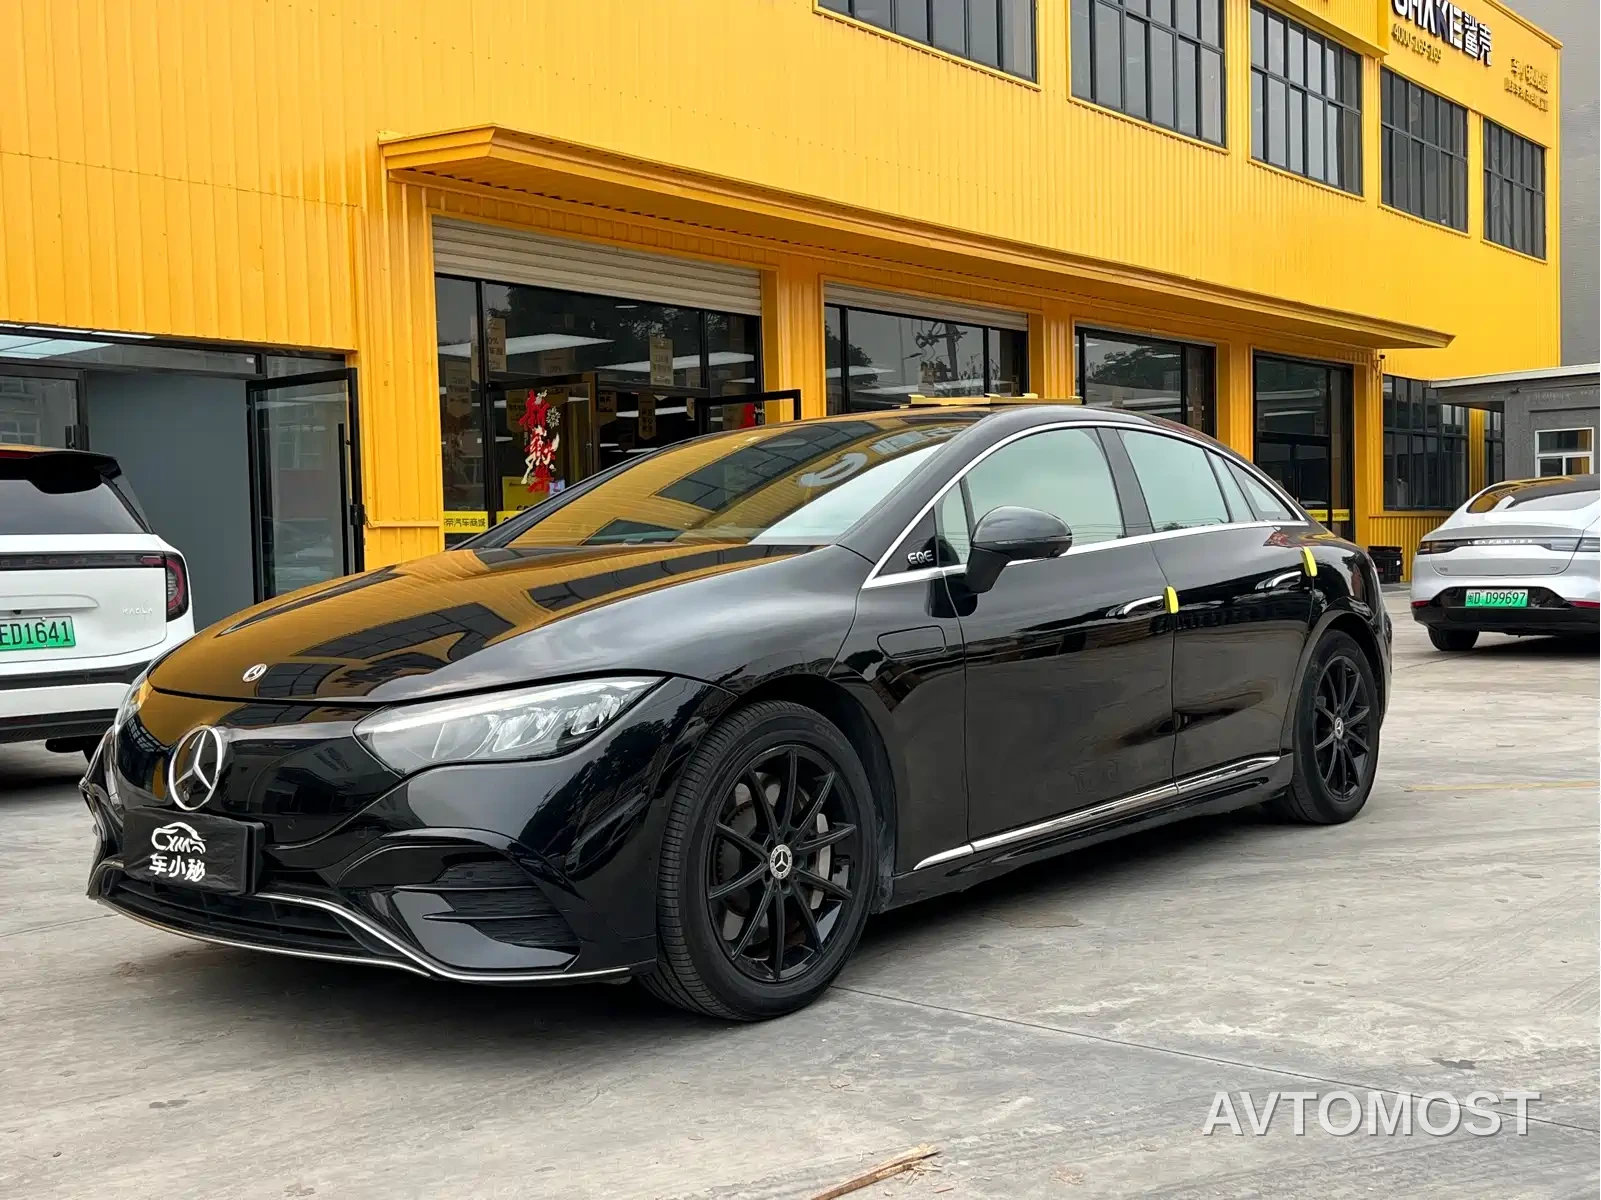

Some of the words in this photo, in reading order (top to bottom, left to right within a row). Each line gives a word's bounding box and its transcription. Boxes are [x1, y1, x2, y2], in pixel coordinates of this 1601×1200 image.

[907, 550, 934, 565] EQE
[148, 852, 206, 882] 车小秘
